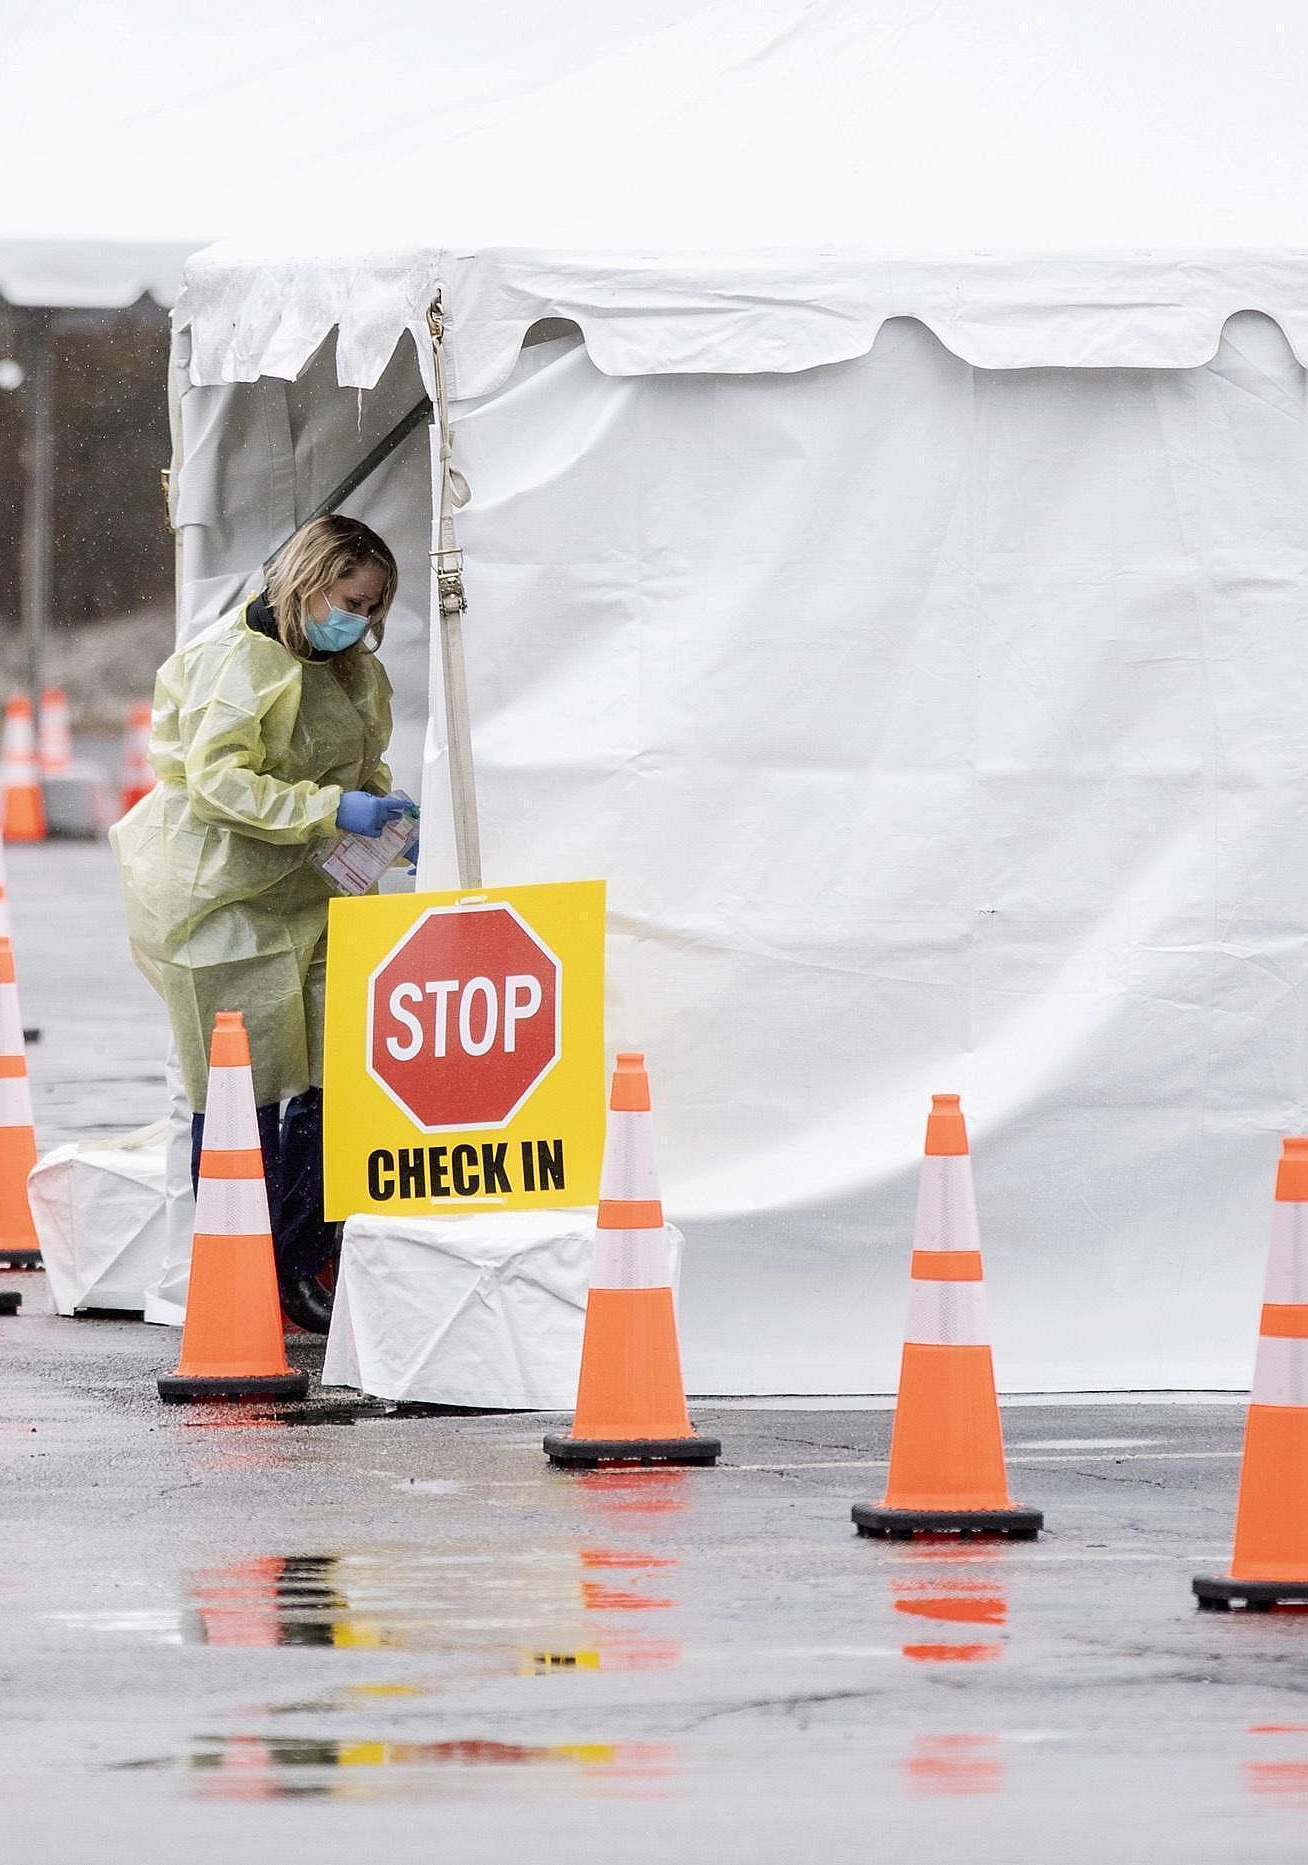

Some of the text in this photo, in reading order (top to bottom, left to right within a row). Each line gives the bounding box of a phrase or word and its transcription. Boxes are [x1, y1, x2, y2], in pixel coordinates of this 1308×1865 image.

[385, 974, 542, 1062] STOP
[367, 1139, 565, 1201] CHECK IN
